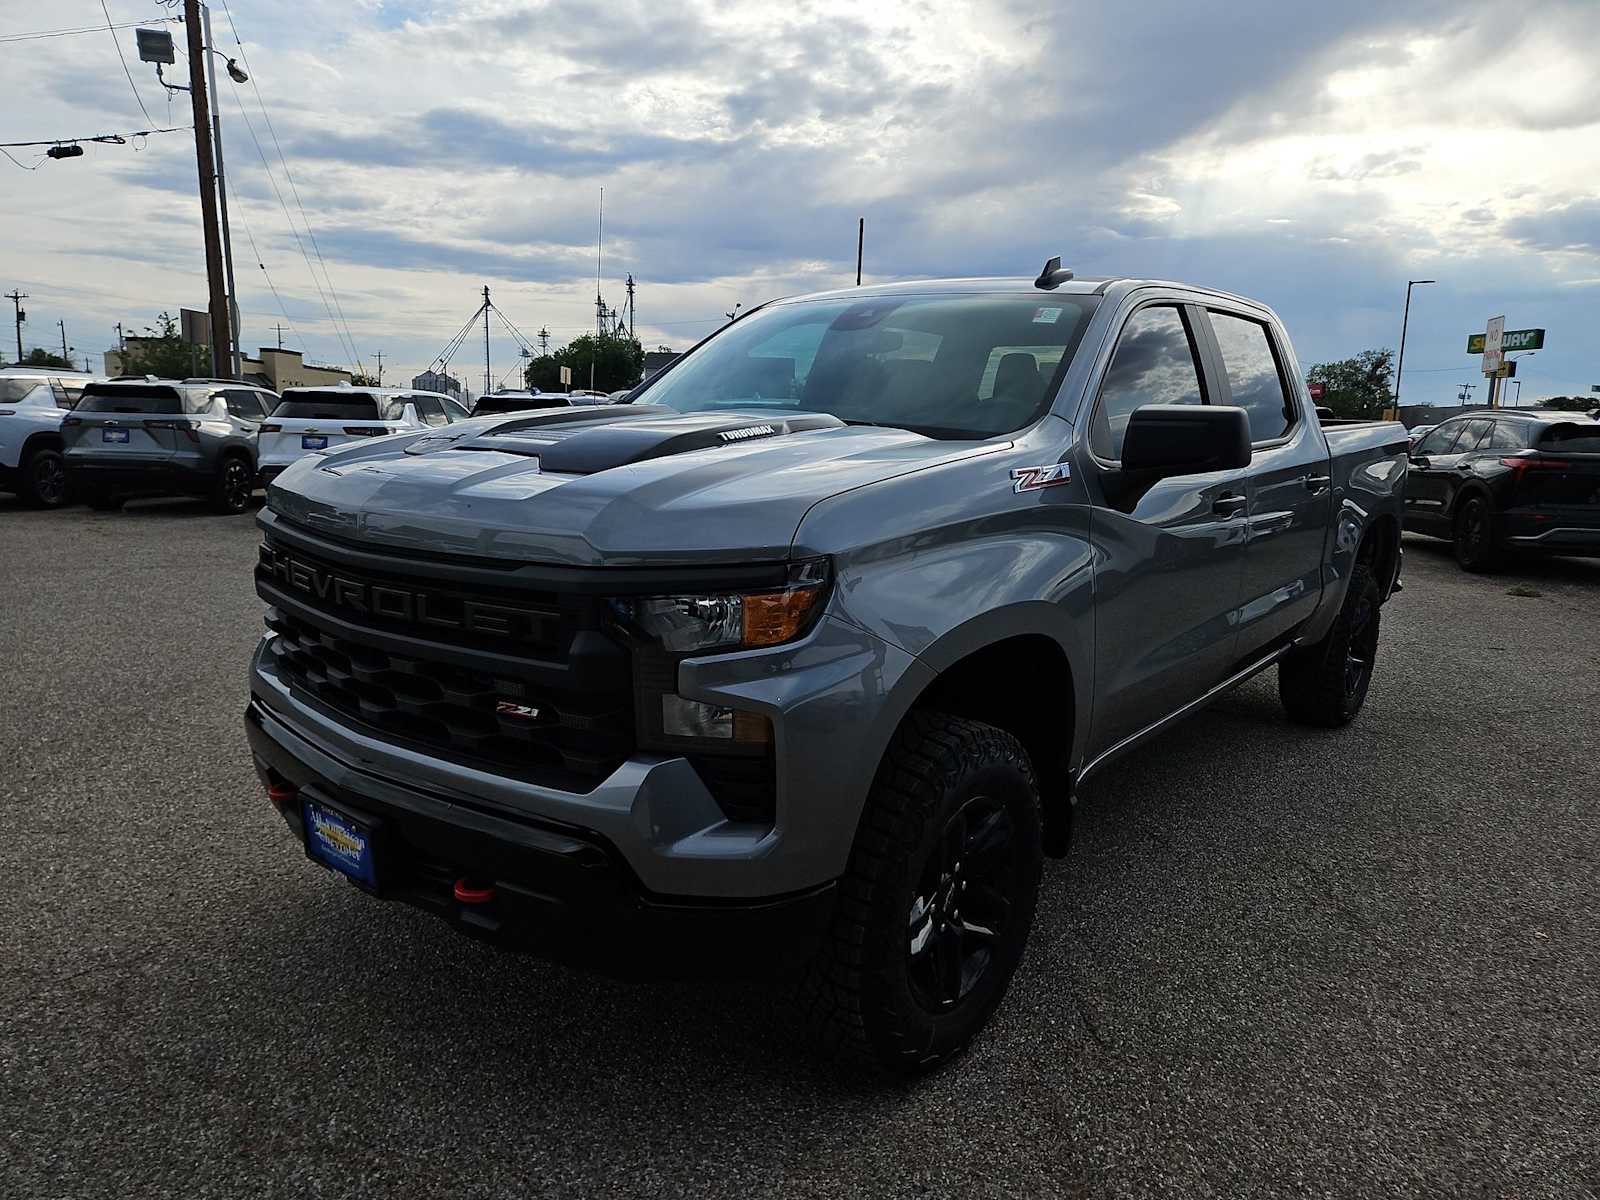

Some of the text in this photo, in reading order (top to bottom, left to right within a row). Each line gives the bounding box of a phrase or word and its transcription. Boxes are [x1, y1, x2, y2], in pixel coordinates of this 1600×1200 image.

[1471, 332, 1535, 350] SWAY
[717, 424, 775, 441] TURBOMAX
[1011, 462, 1071, 493] Z71
[258, 542, 561, 637] CHEVROLET
[495, 701, 540, 719] Z71
